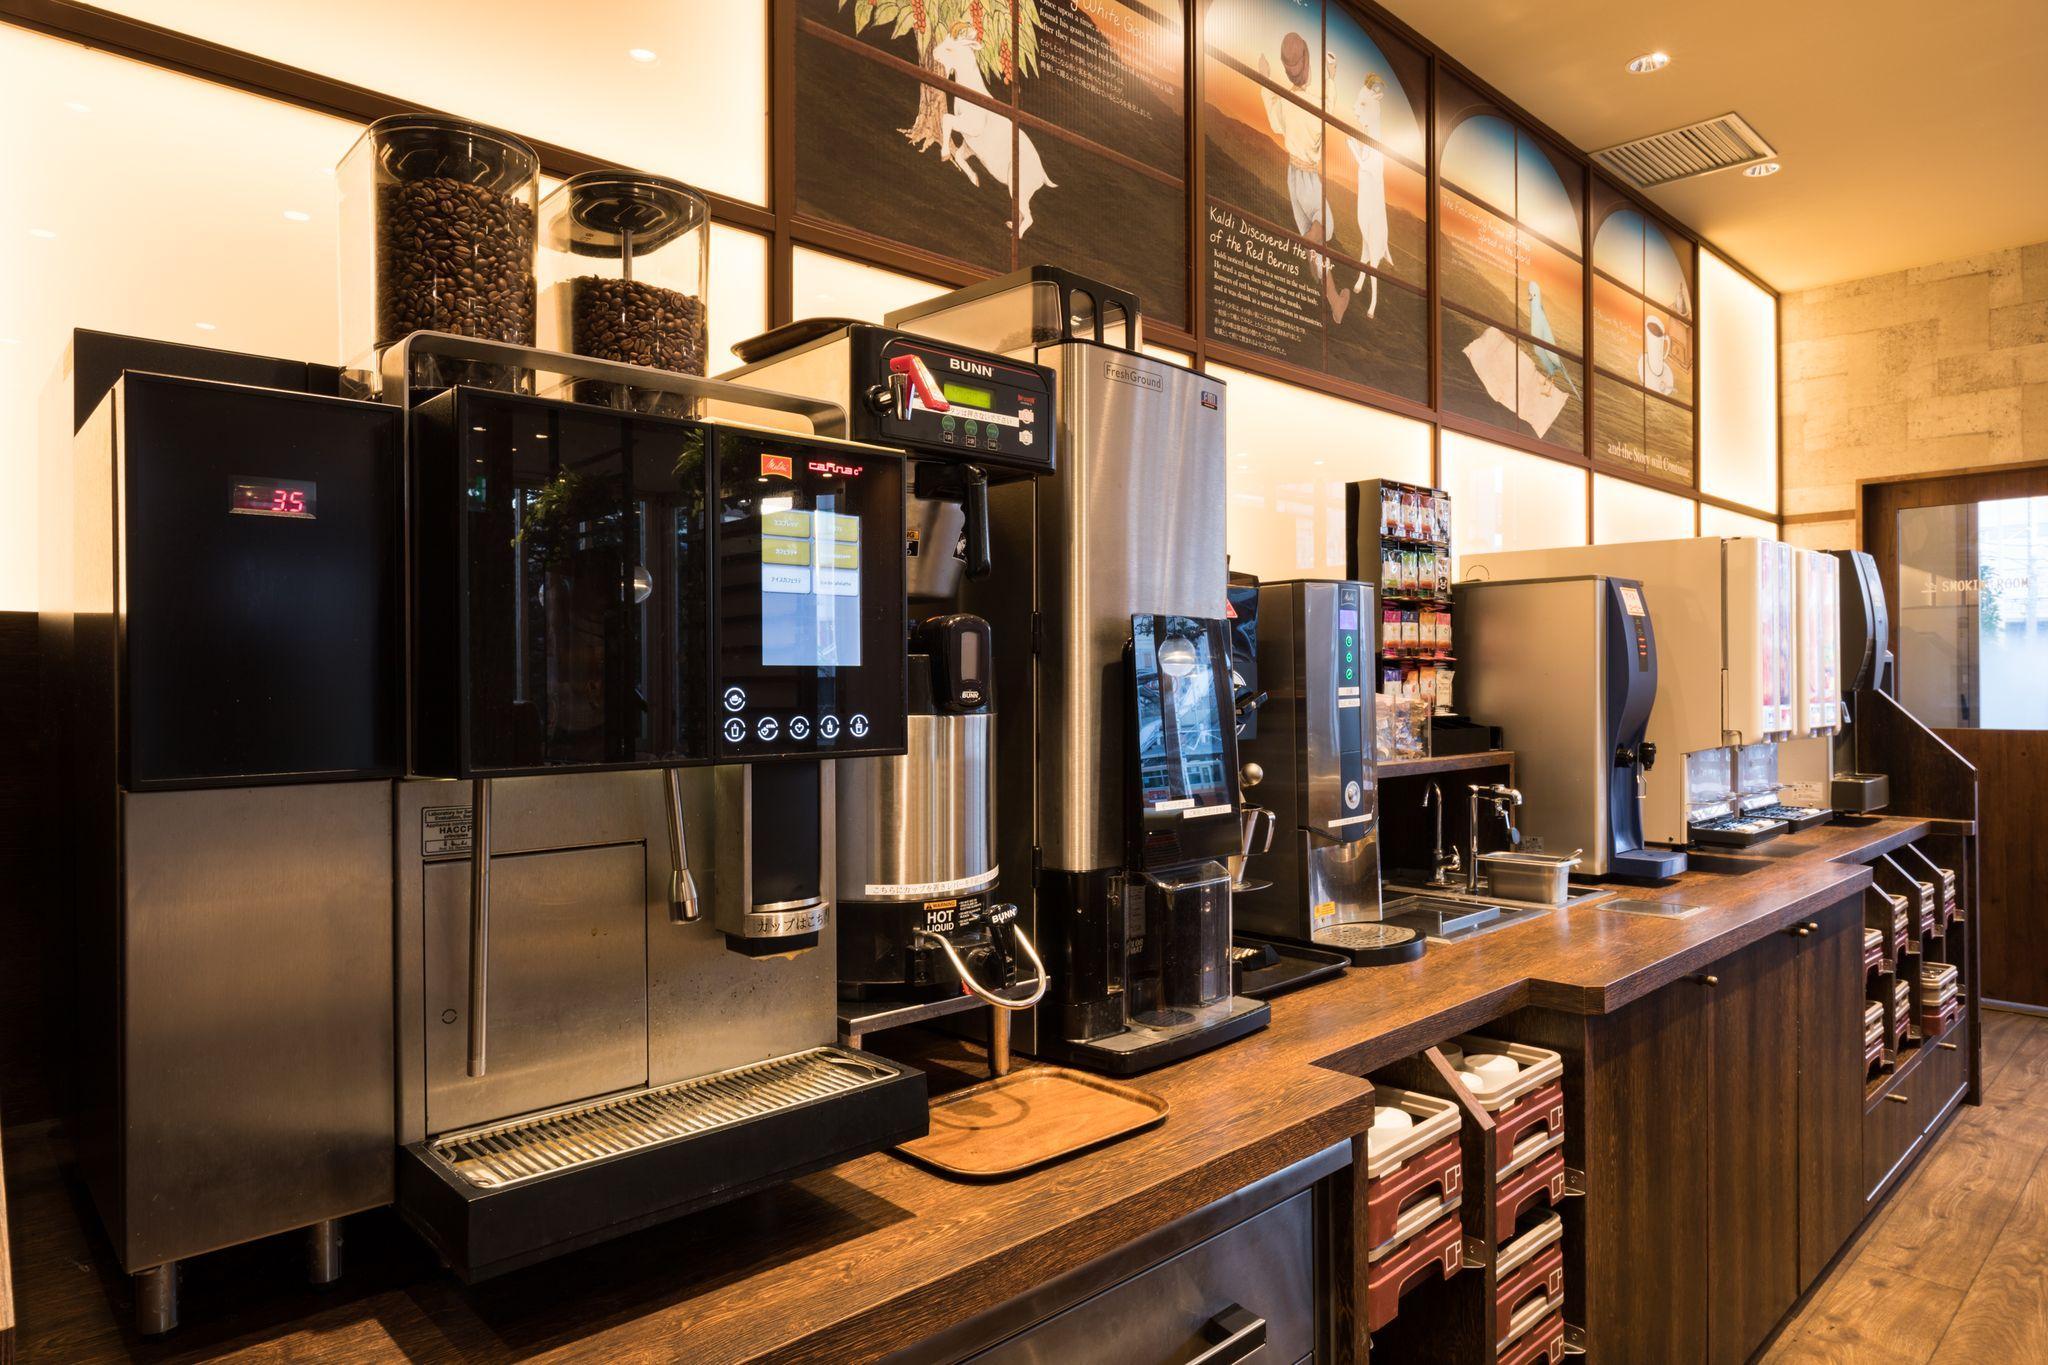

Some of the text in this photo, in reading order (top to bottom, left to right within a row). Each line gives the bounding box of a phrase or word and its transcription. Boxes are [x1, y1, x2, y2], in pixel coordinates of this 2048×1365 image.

[1209, 206, 1235, 229] Kaldi
[1239, 219, 1290, 252] Discovered
[1292, 242, 1307, 260] the
[1209, 229, 1300, 276] of the Red Berries
[950, 358, 993, 377] BUNN
[1105, 364, 1162, 389] FreshGround
[1607, 441, 1620, 456] and
[1620, 443, 1633, 461] the
[1633, 447, 1650, 466] Story
[1651, 454, 1663, 470] will
[271, 489, 304, 512] 3.5
[758, 906, 829, 933] カップはこち
[926, 922, 955, 933] LIQUID
[927, 909, 955, 924] HOT
[991, 908, 1017, 924] BUNN
